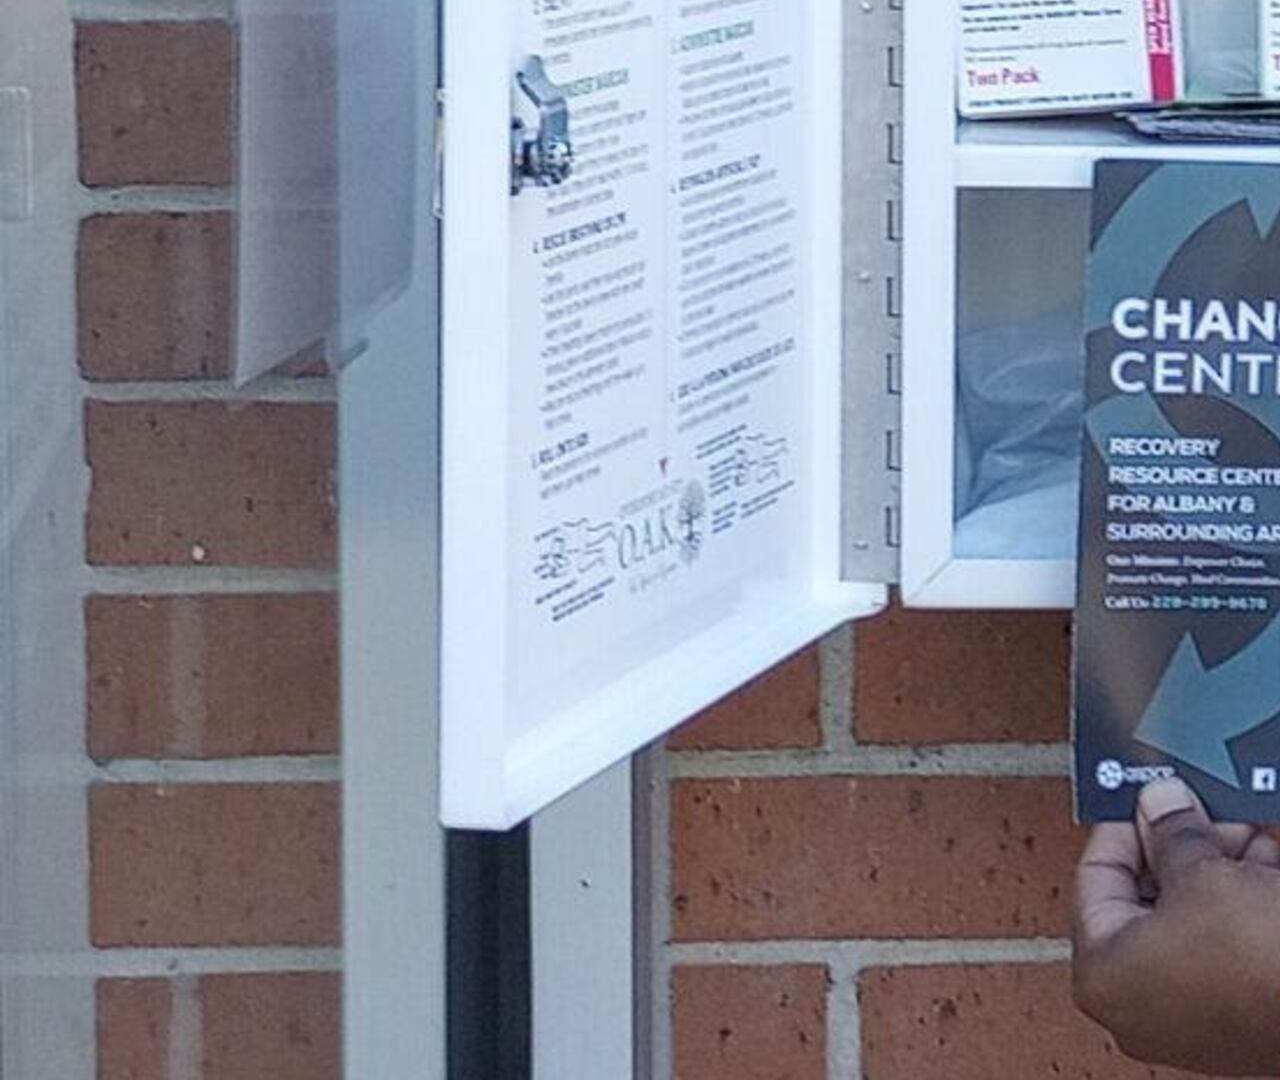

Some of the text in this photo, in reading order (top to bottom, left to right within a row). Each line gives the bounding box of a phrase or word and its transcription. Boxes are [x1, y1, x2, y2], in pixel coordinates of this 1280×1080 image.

[967, 67, 1040, 87] Two Pack
[1109, 438, 1220, 456] RECOVERY
[1109, 466, 1219, 484] RESOURCE
[1107, 494, 1255, 513] FOR ALBANY &
[1106, 523, 1255, 542] SURROUNDING
